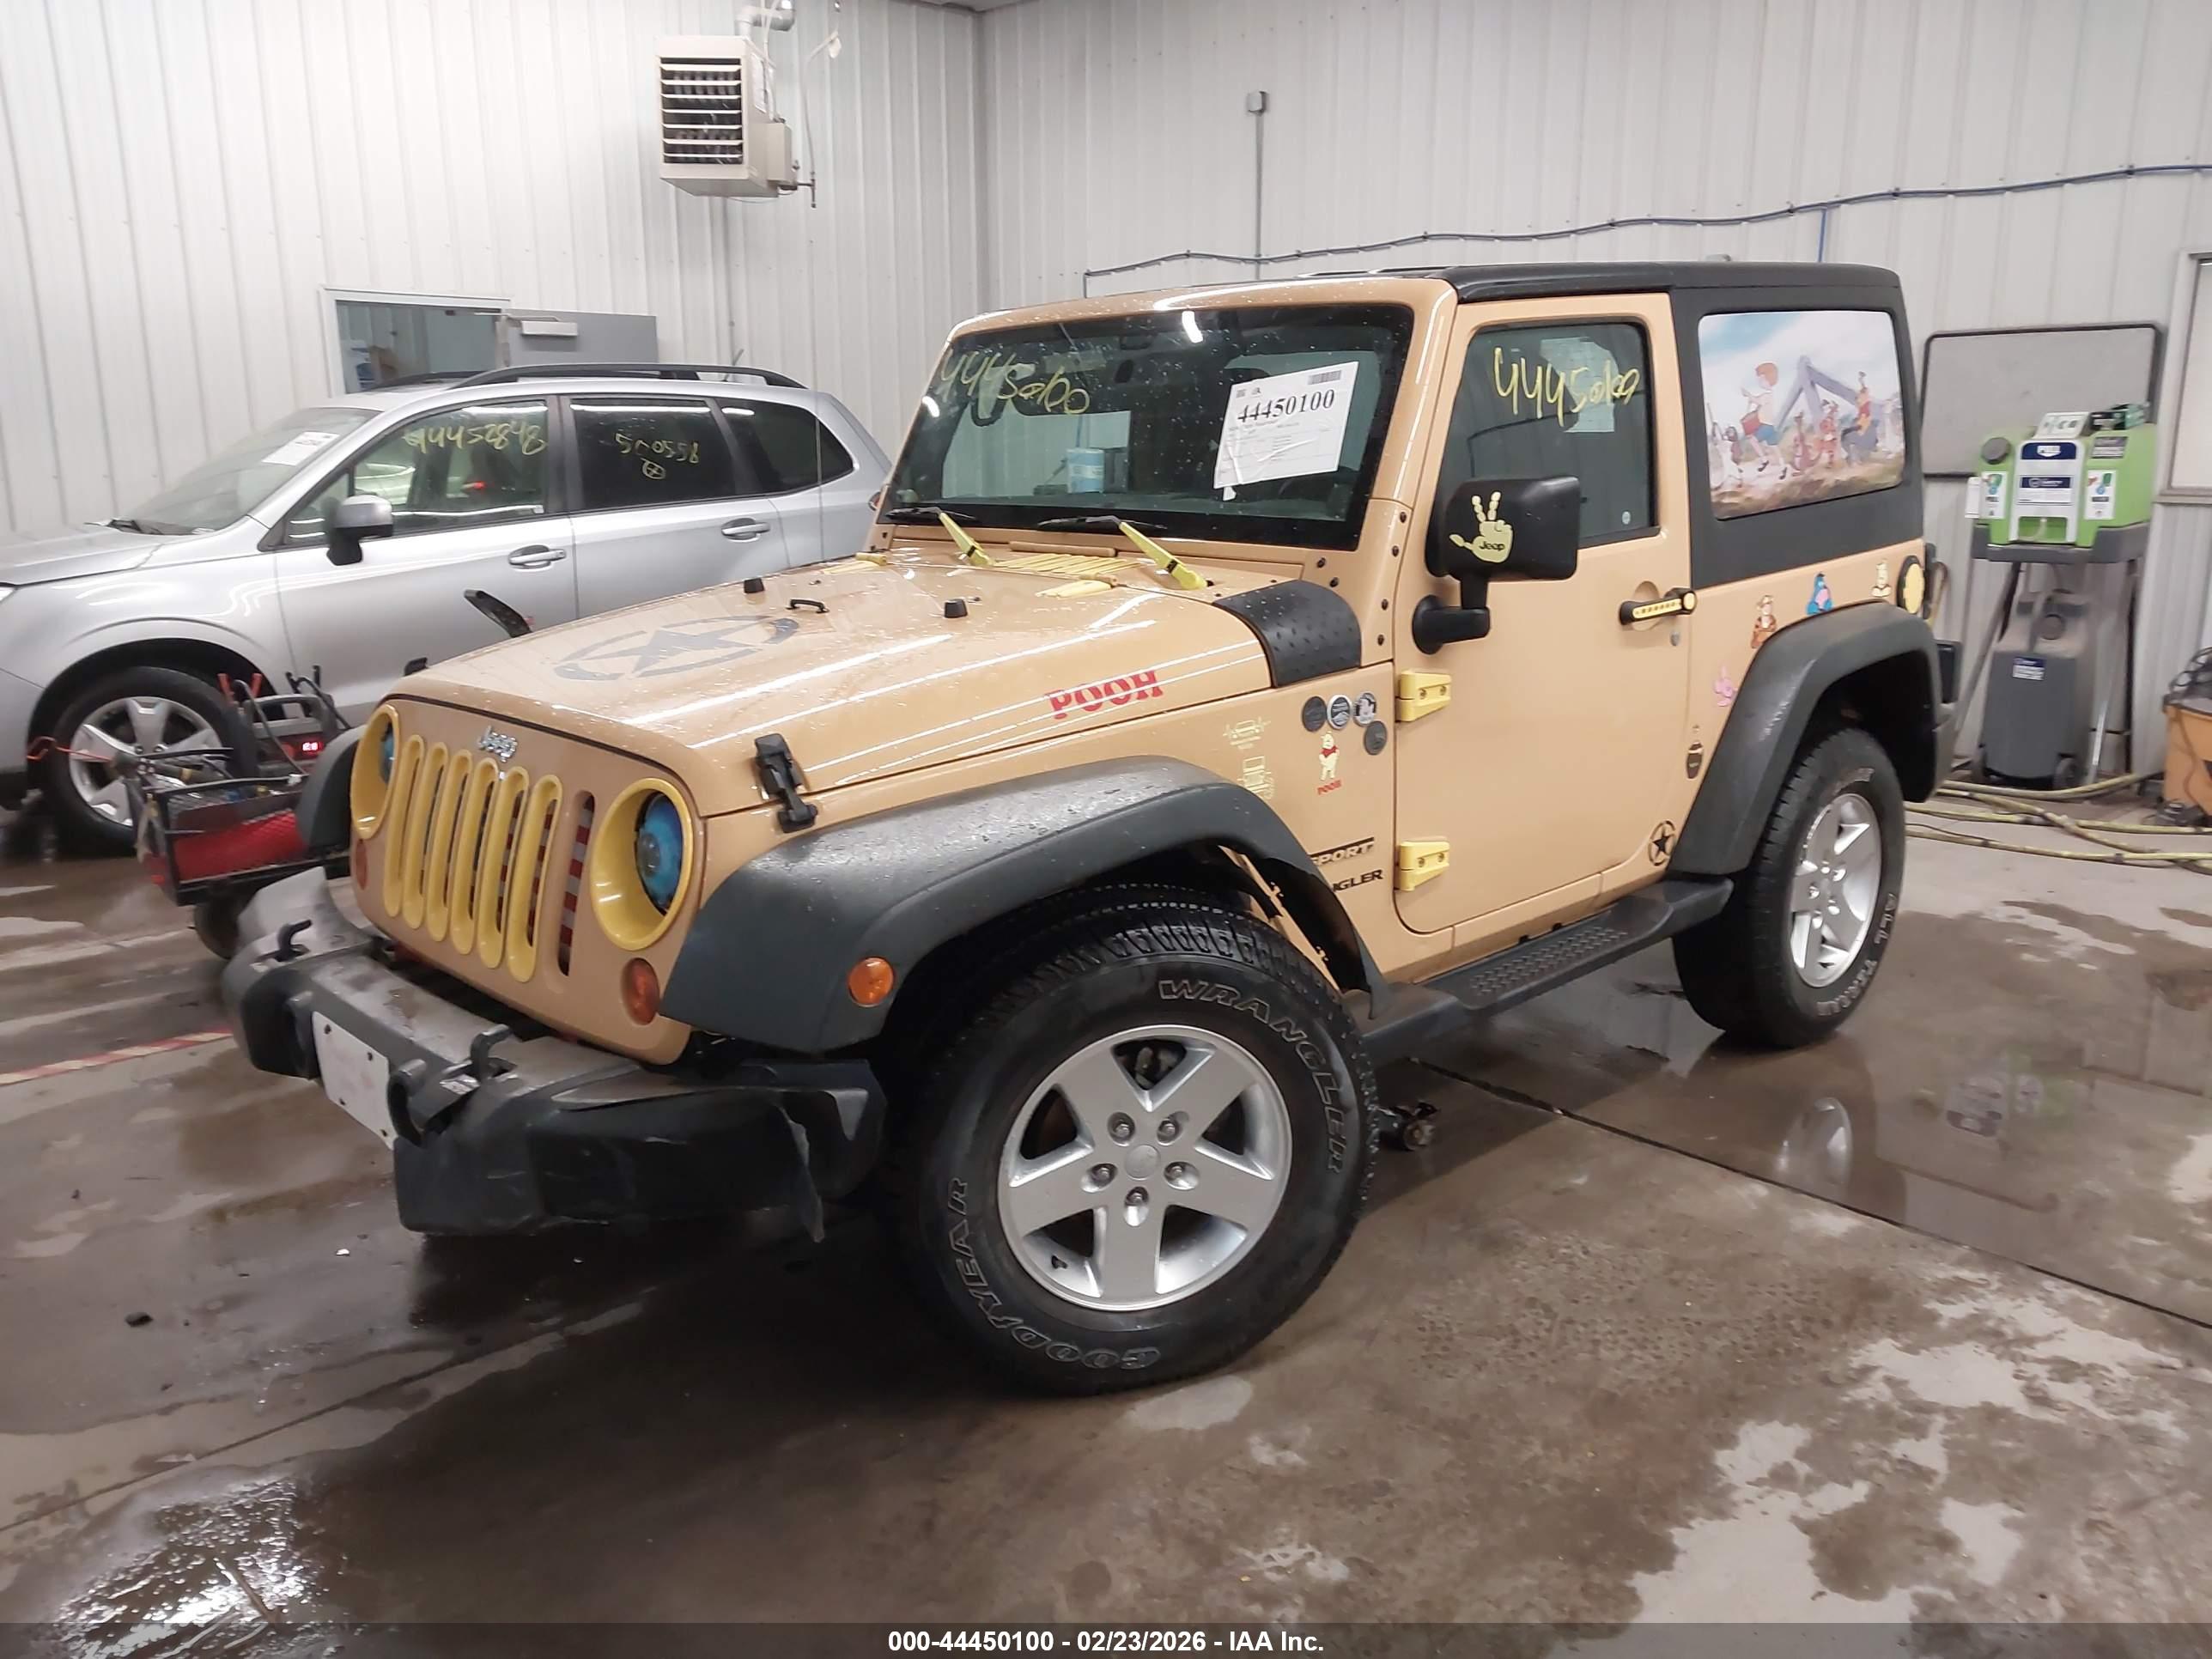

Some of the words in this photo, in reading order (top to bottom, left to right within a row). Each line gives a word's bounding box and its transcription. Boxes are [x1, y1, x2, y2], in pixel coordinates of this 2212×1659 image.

[1237, 389, 1334, 422] 44450100
[1479, 541, 1505, 551] Jeep
[1043, 670, 1164, 720] POOH
[1159, 979, 1347, 1174] WRANGLER
[948, 1177, 1160, 1370] GOODYEAR
